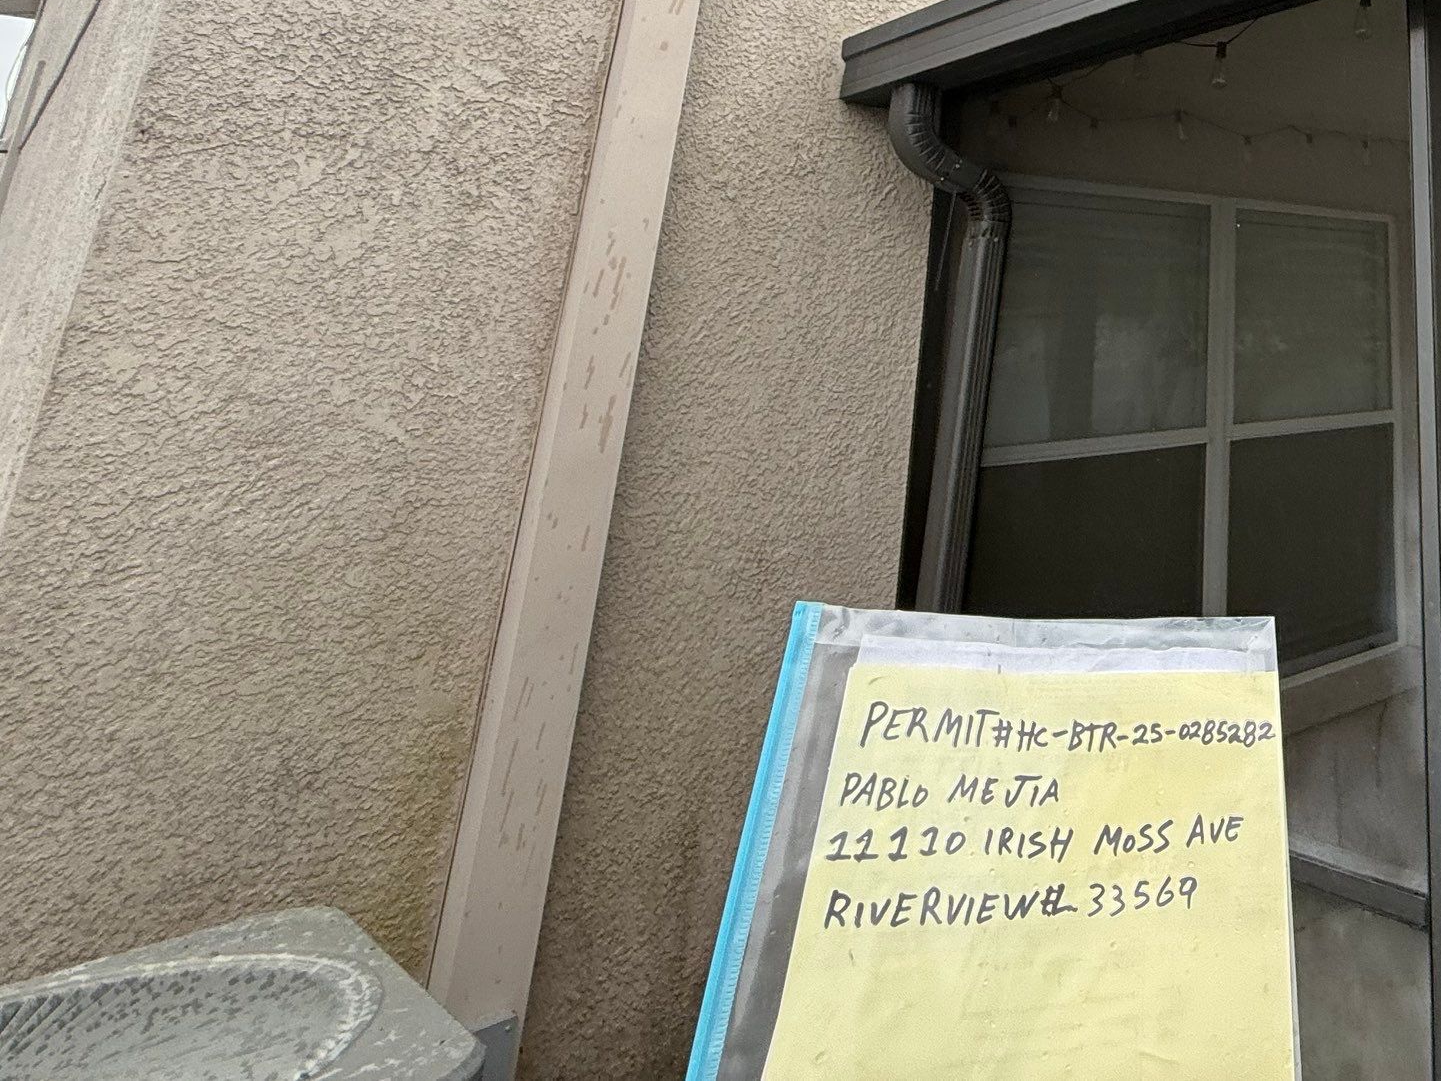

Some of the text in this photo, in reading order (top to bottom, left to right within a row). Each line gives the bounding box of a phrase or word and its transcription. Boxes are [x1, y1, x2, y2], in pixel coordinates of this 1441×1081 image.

[947, 774, 1060, 807] MEJIA
[825, 825, 966, 862] 11110
[984, 826, 1073, 862] IRISH
[1186, 814, 1244, 847] AVE
[1087, 875, 1198, 917] 33569
